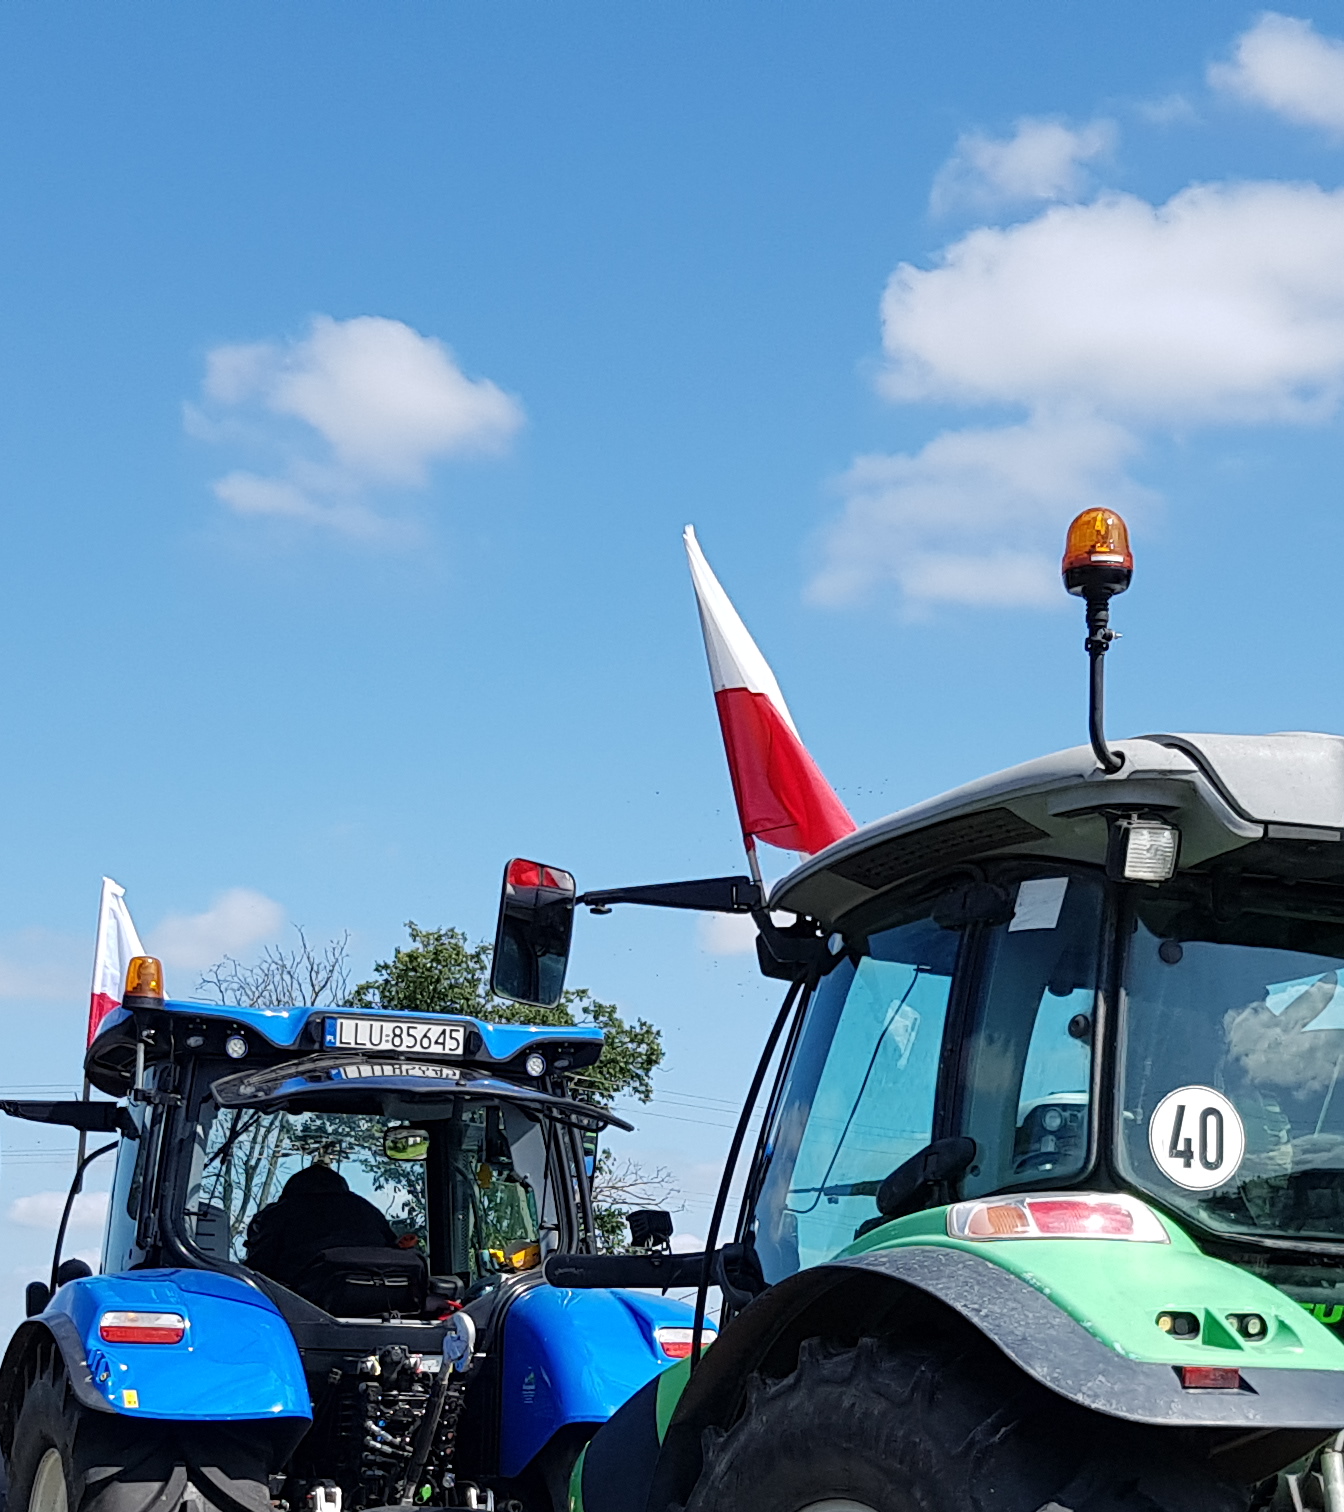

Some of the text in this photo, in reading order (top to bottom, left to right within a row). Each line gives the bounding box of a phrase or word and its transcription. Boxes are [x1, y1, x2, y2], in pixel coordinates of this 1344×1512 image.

[326, 1035, 336, 1043] PL
[391, 1025, 462, 1052] 85645
[1168, 1104, 1224, 1171] 40
